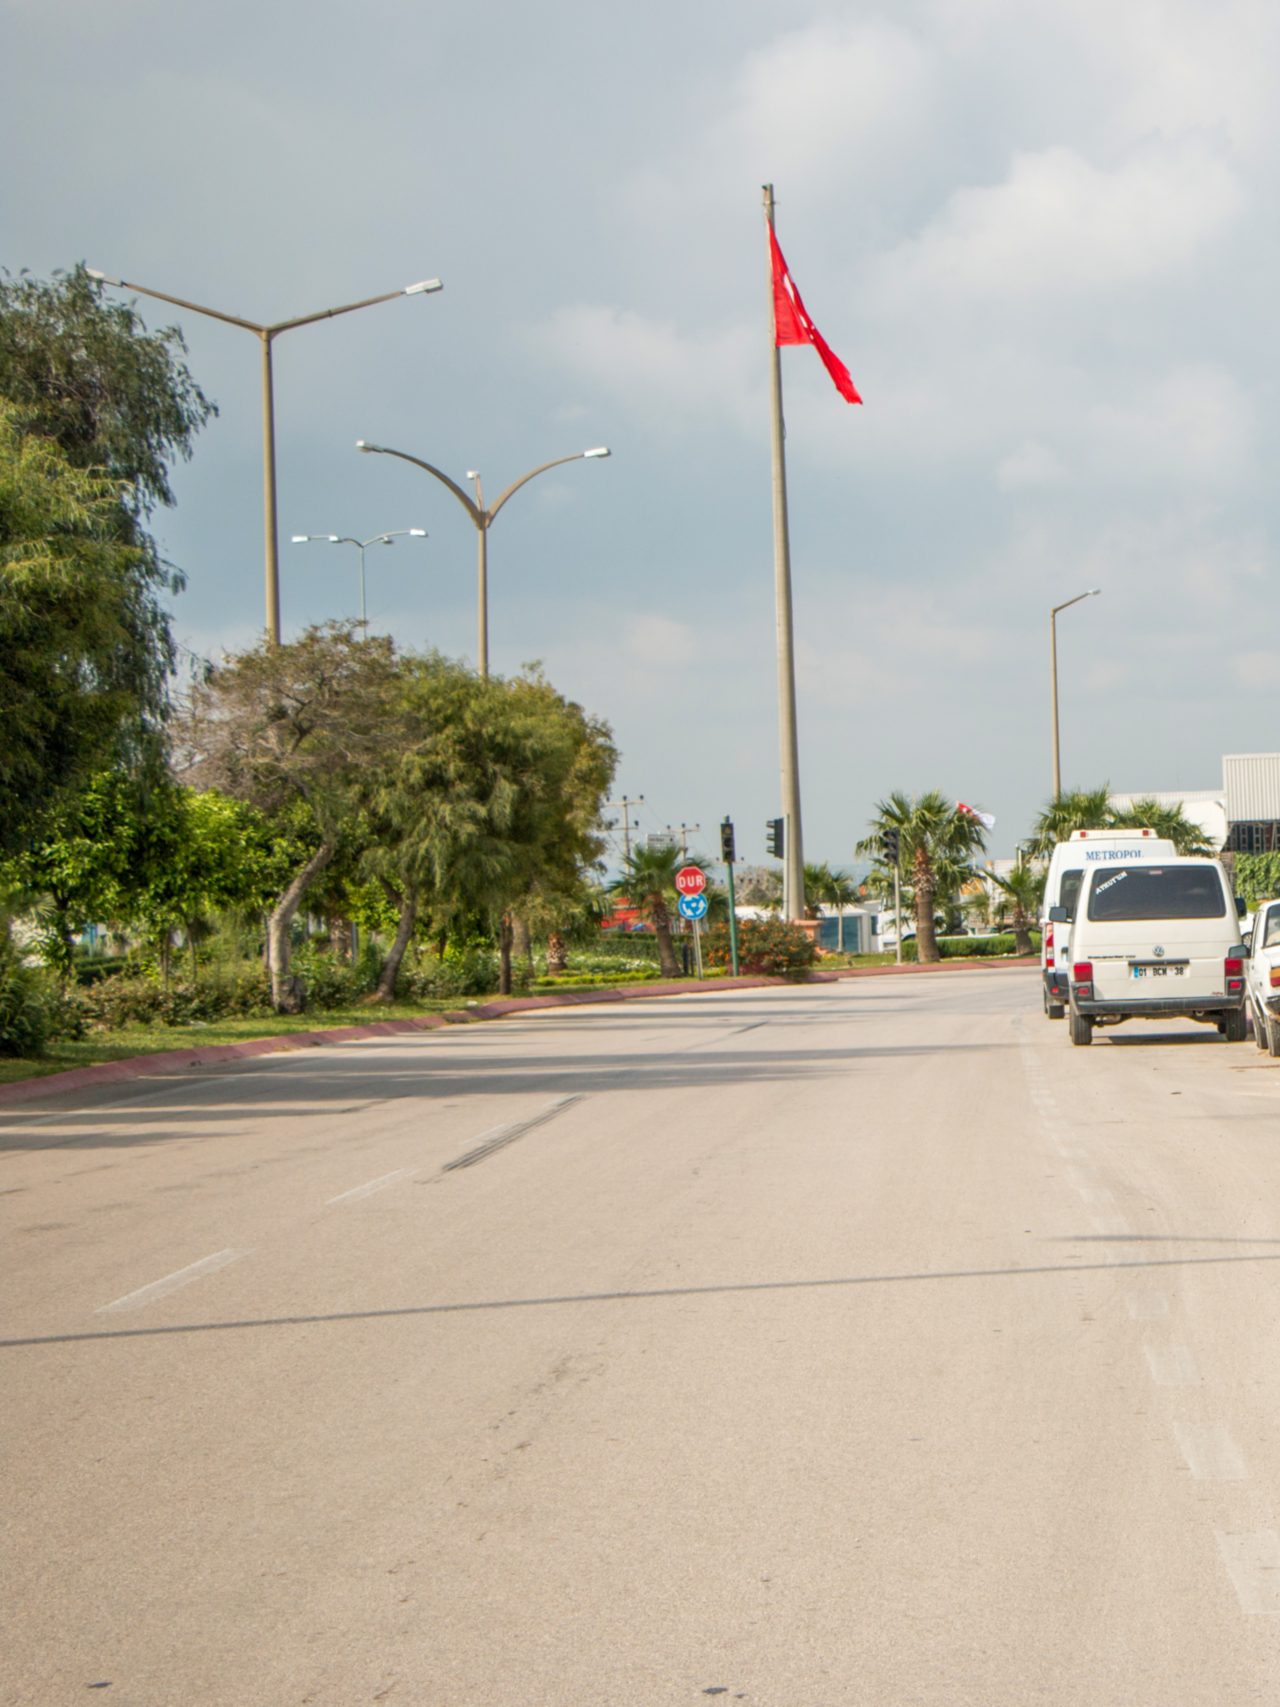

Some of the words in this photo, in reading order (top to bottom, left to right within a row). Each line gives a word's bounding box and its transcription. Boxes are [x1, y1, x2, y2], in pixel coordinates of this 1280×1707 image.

[1086, 849, 1144, 861] METROPOL
[679, 875, 704, 888] DUR
[1139, 968, 1147, 976] 01
